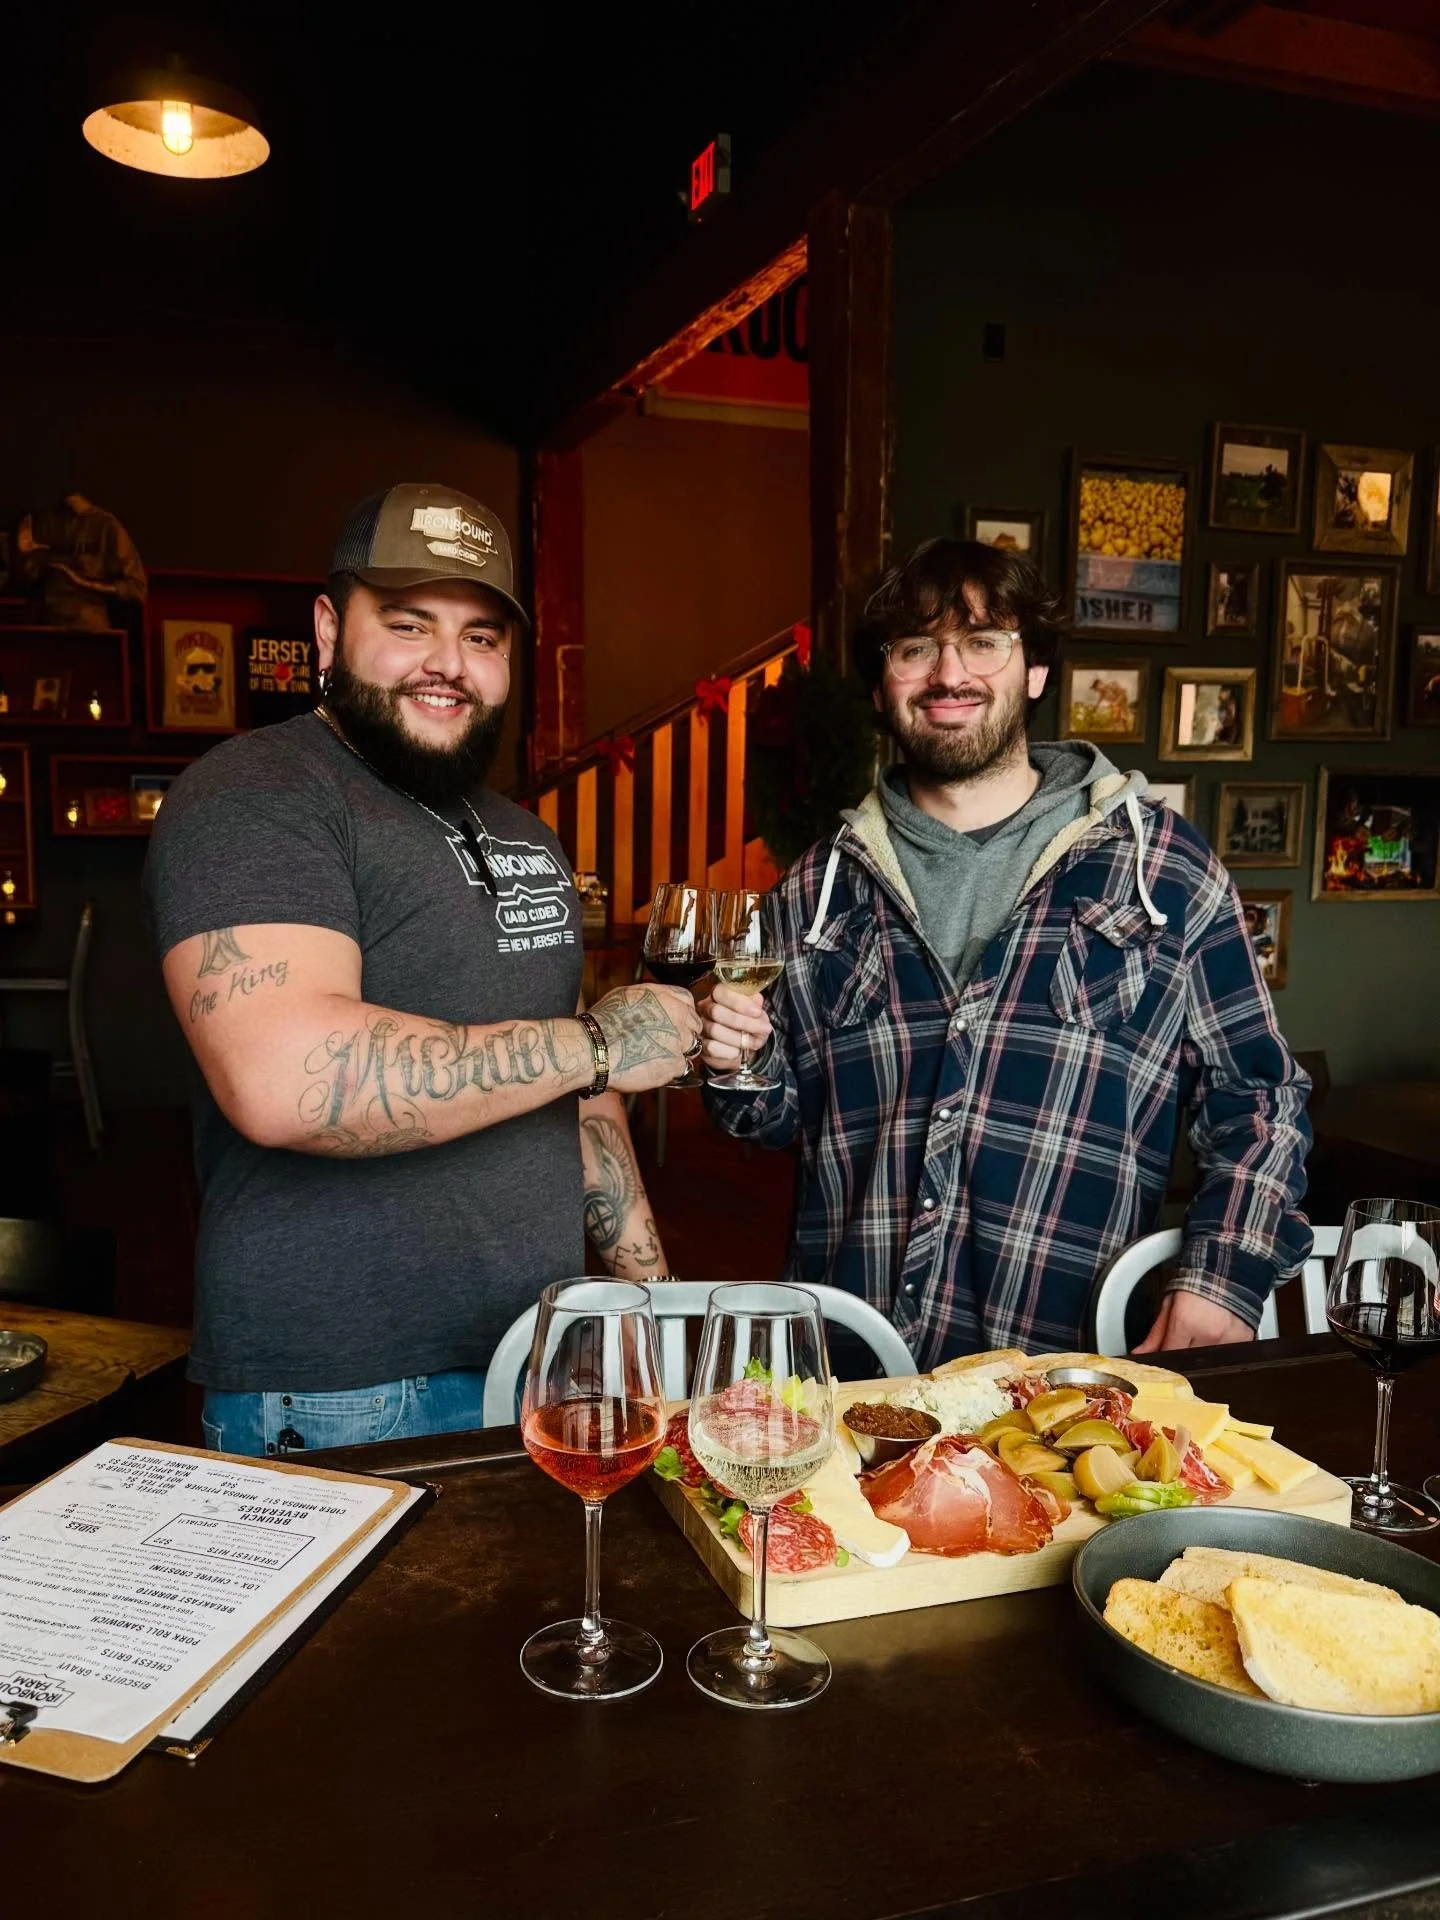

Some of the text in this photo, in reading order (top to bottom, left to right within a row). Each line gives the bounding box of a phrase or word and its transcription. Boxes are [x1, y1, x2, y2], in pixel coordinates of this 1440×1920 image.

[248, 639, 311, 664] JERSEY
[529, 905, 560, 922] CIDER
[510, 931, 562, 952] NEW JERSEY
[227, 960, 289, 1002] King
[119, 1460, 147, 1469] CIDER
[139, 1456, 164, 1464] JUICE
[163, 1460, 199, 1470] ORANGE
[104, 1465, 132, 1473] CIDER
[130, 1469, 166, 1480] MULLED
[145, 1465, 174, 1474] APPLE
[172, 1469, 191, 1477] N/A
[134, 1485, 168, 1495] COFFEE
[183, 1482, 222, 1493] PITCHER
[220, 1489, 258, 1500] MIMOSA
[261, 1496, 281, 1504] $12
[279, 1500, 318, 1510] MIMOSA
[317, 1506, 347, 1514] CIDER
[236, 1505, 310, 1518] BEVERAGES
[238, 1513, 293, 1525] BRUNCH
[64, 1521, 99, 1533] SIDES
[205, 1546, 231, 1555] HITS
[228, 1551, 280, 1565] GREATEST
[147, 1564, 194, 1577] CROSTINI
[239, 1582, 261, 1590] LOX
[134, 1587, 179, 1600] BURRITO
[177, 1596, 236, 1613] BREAKFAST
[89, 1615, 201, 1645] PORK ROLL SANDWICH
[98, 1648, 133, 1661] GRITS
[55, 1662, 93, 1676] GRAVY
[130, 1657, 173, 1671] CHEESY
[11, 1675, 53, 1690] FARM
[100, 1674, 151, 1689] BISCUITS
[0, 1682, 62, 1703] IRONBOU
